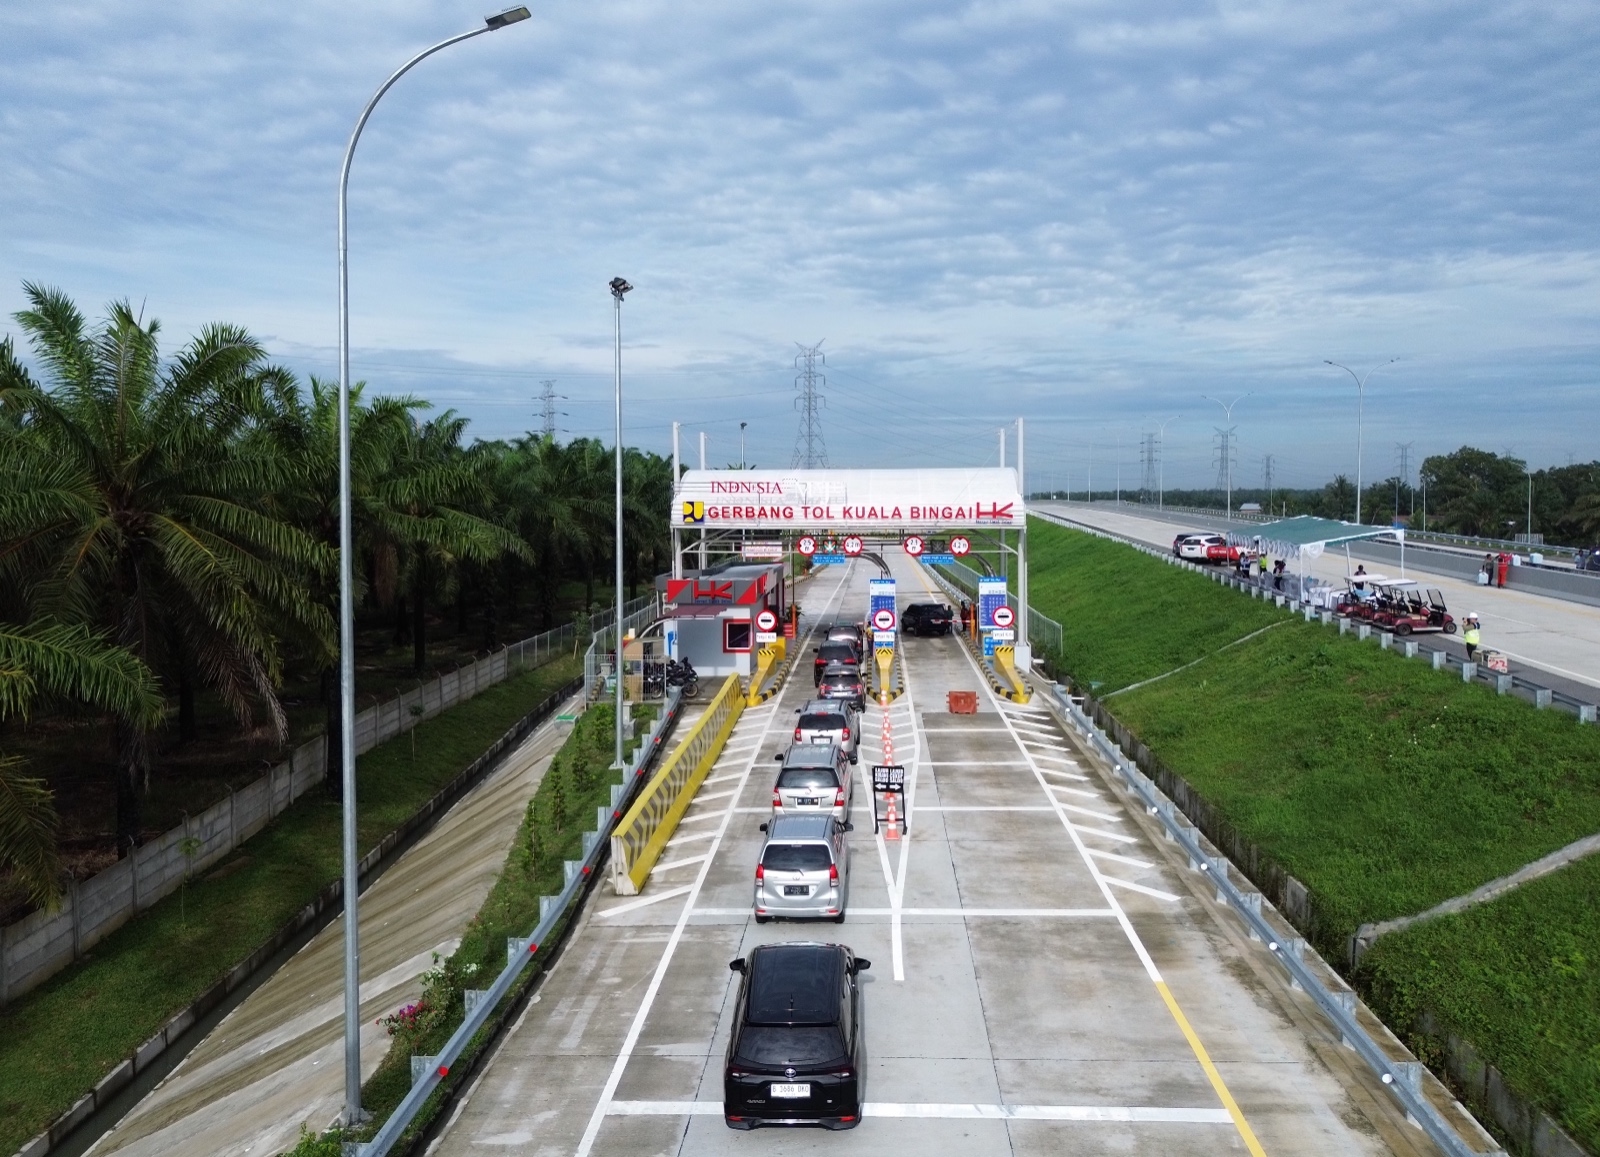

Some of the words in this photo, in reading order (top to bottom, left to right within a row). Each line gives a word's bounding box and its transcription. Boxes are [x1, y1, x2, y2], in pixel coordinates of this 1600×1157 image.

[707, 505, 794, 519] GERBANG
[801, 506, 834, 519] TOL
[843, 505, 902, 519] KUALA
[910, 505, 973, 519] BINGAI
[976, 501, 1014, 519] HK
[693, 580, 733, 600] HK
